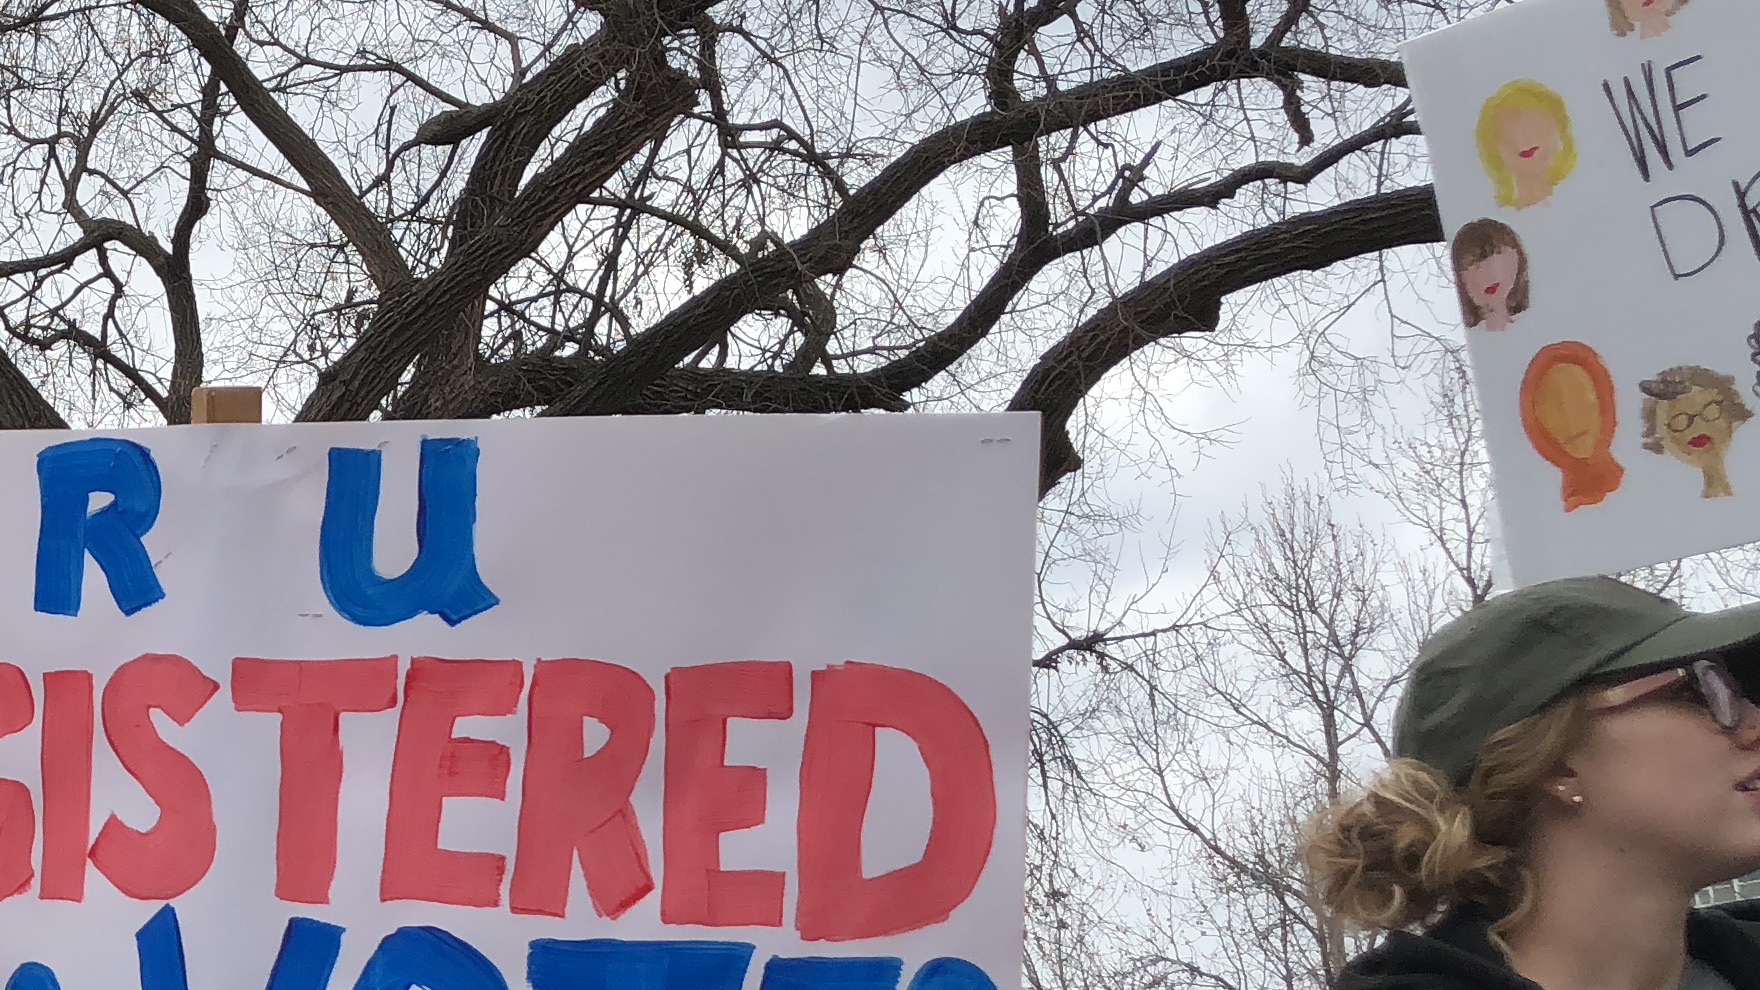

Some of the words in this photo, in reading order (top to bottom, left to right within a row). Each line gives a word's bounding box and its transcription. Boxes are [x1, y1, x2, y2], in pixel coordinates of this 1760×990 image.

[1601, 54, 1723, 183] WE
[33, 437, 166, 618] R
[319, 437, 501, 628] U
